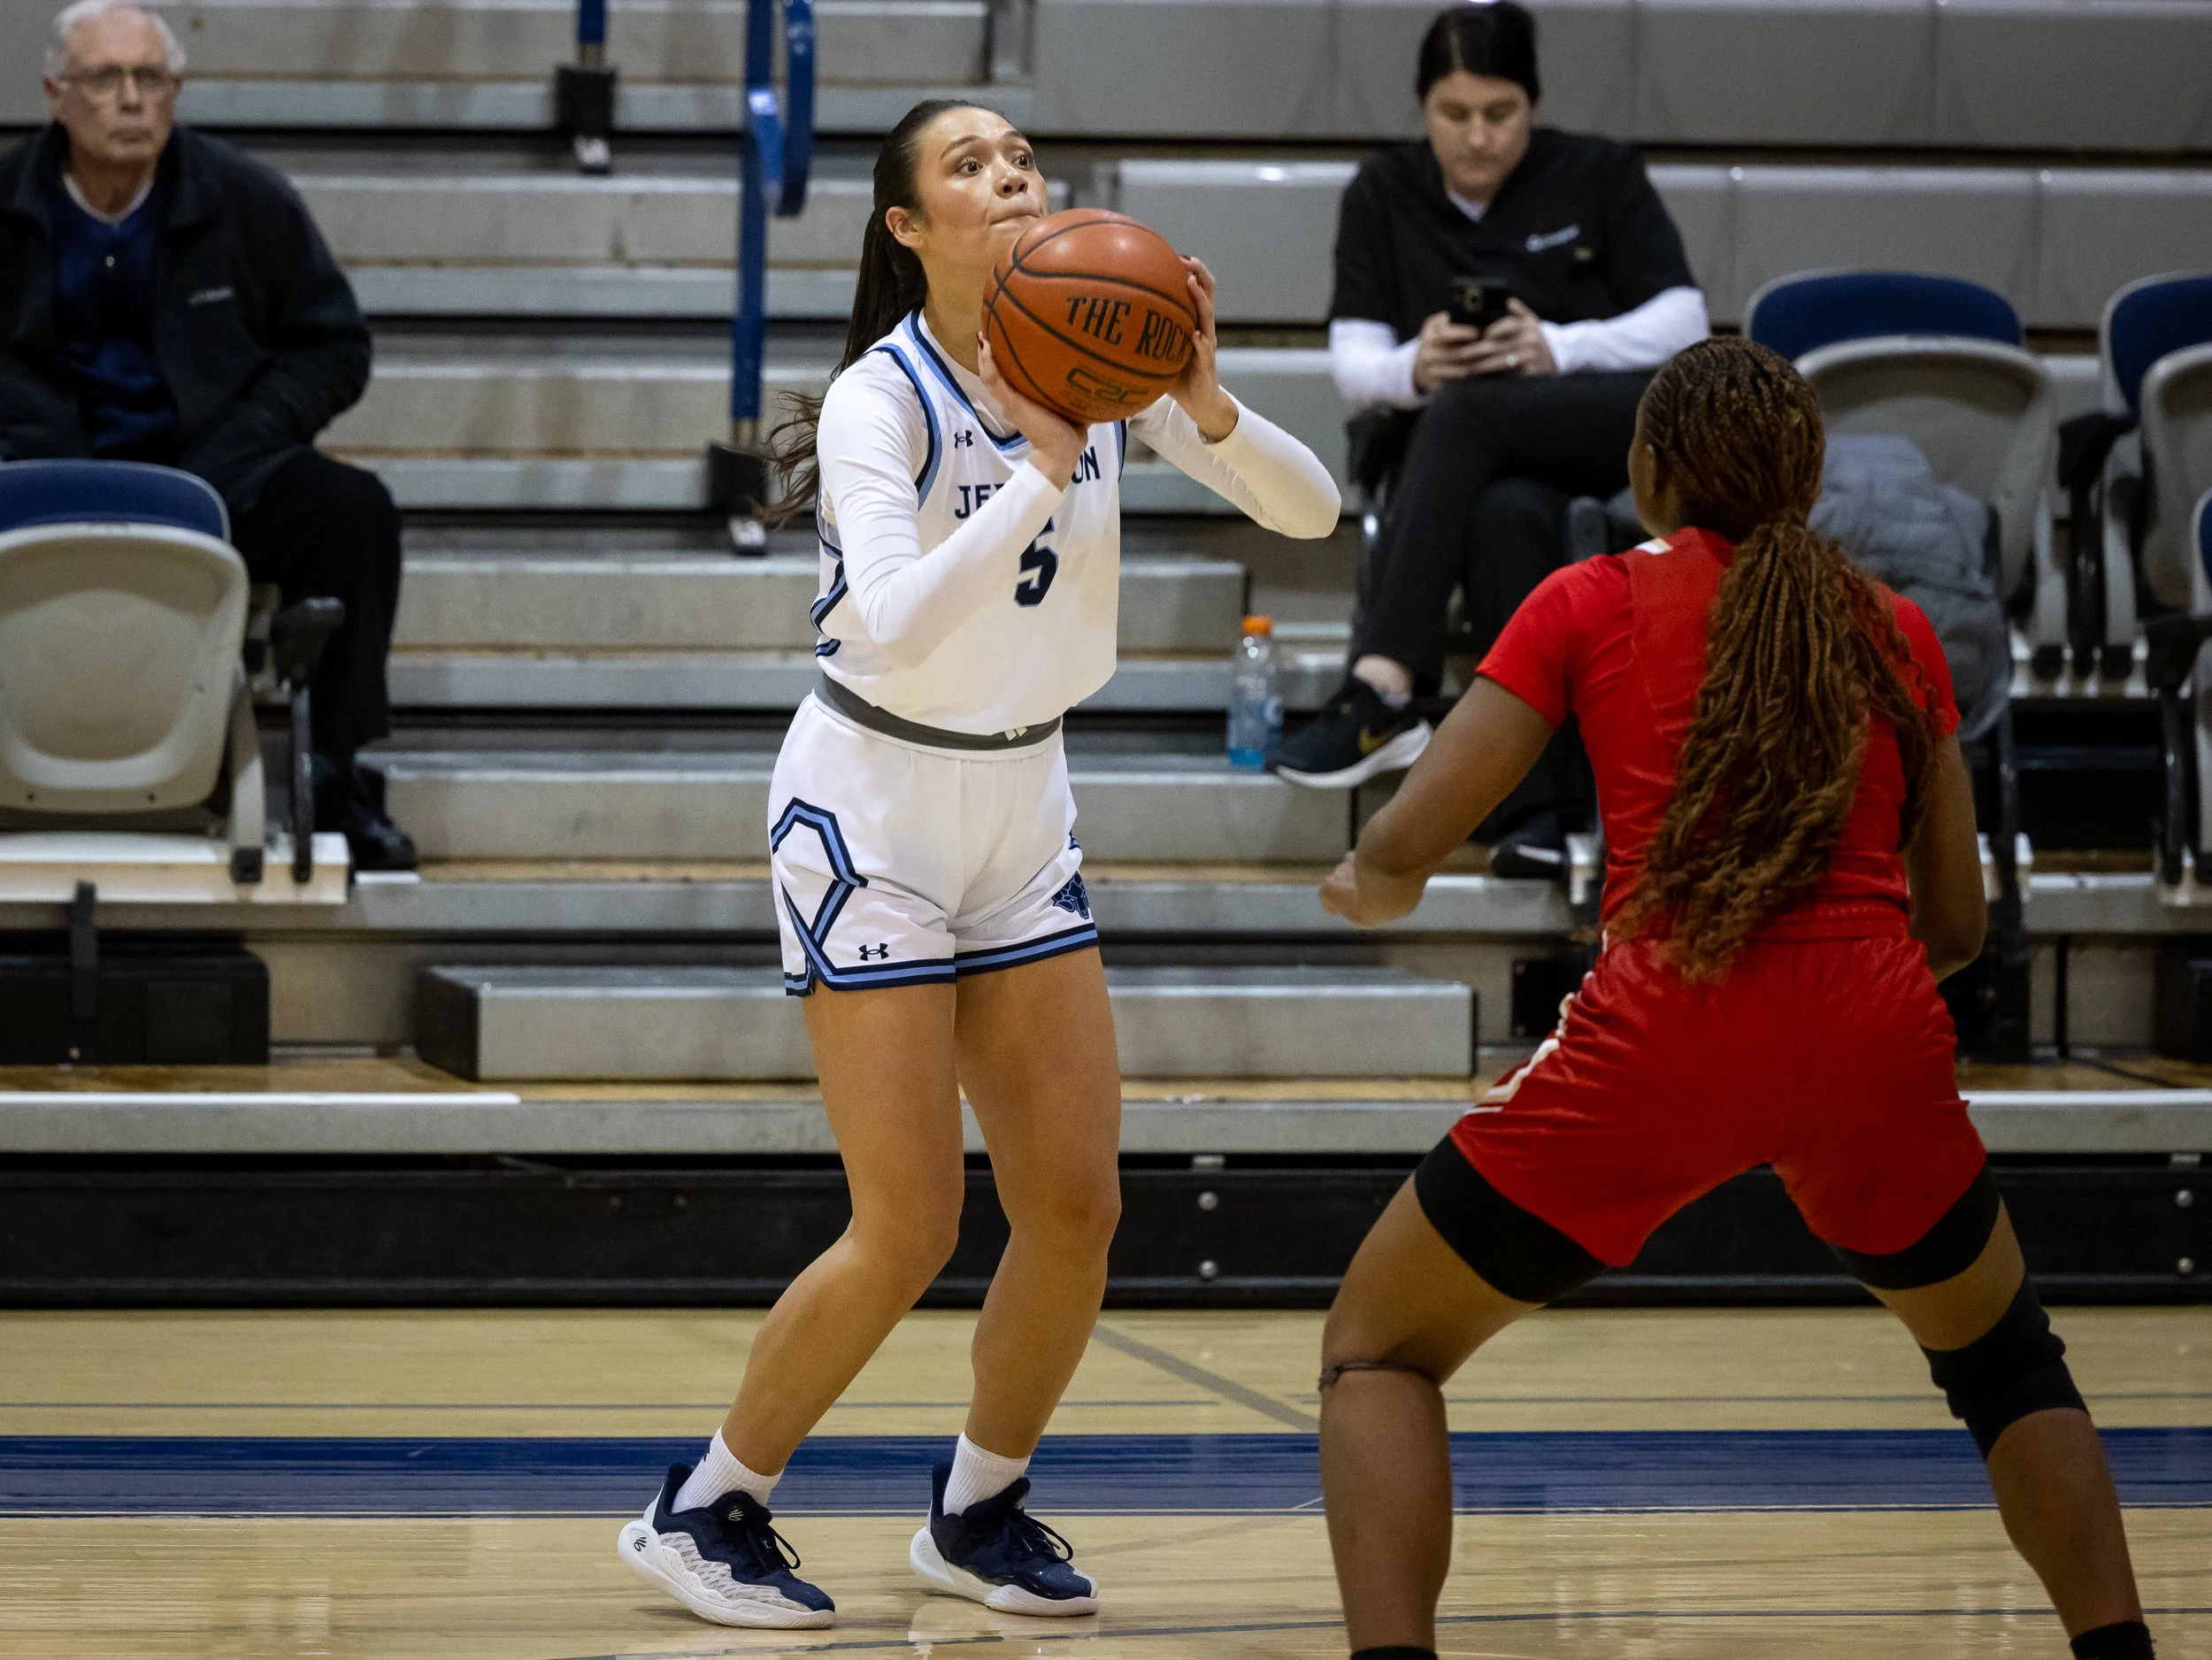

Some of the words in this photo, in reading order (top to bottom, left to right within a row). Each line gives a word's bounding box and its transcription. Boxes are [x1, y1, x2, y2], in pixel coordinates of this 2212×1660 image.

[1066, 296, 1132, 346] THE
[1134, 310, 1191, 362] ROCK
[1013, 516, 1059, 608] 5
